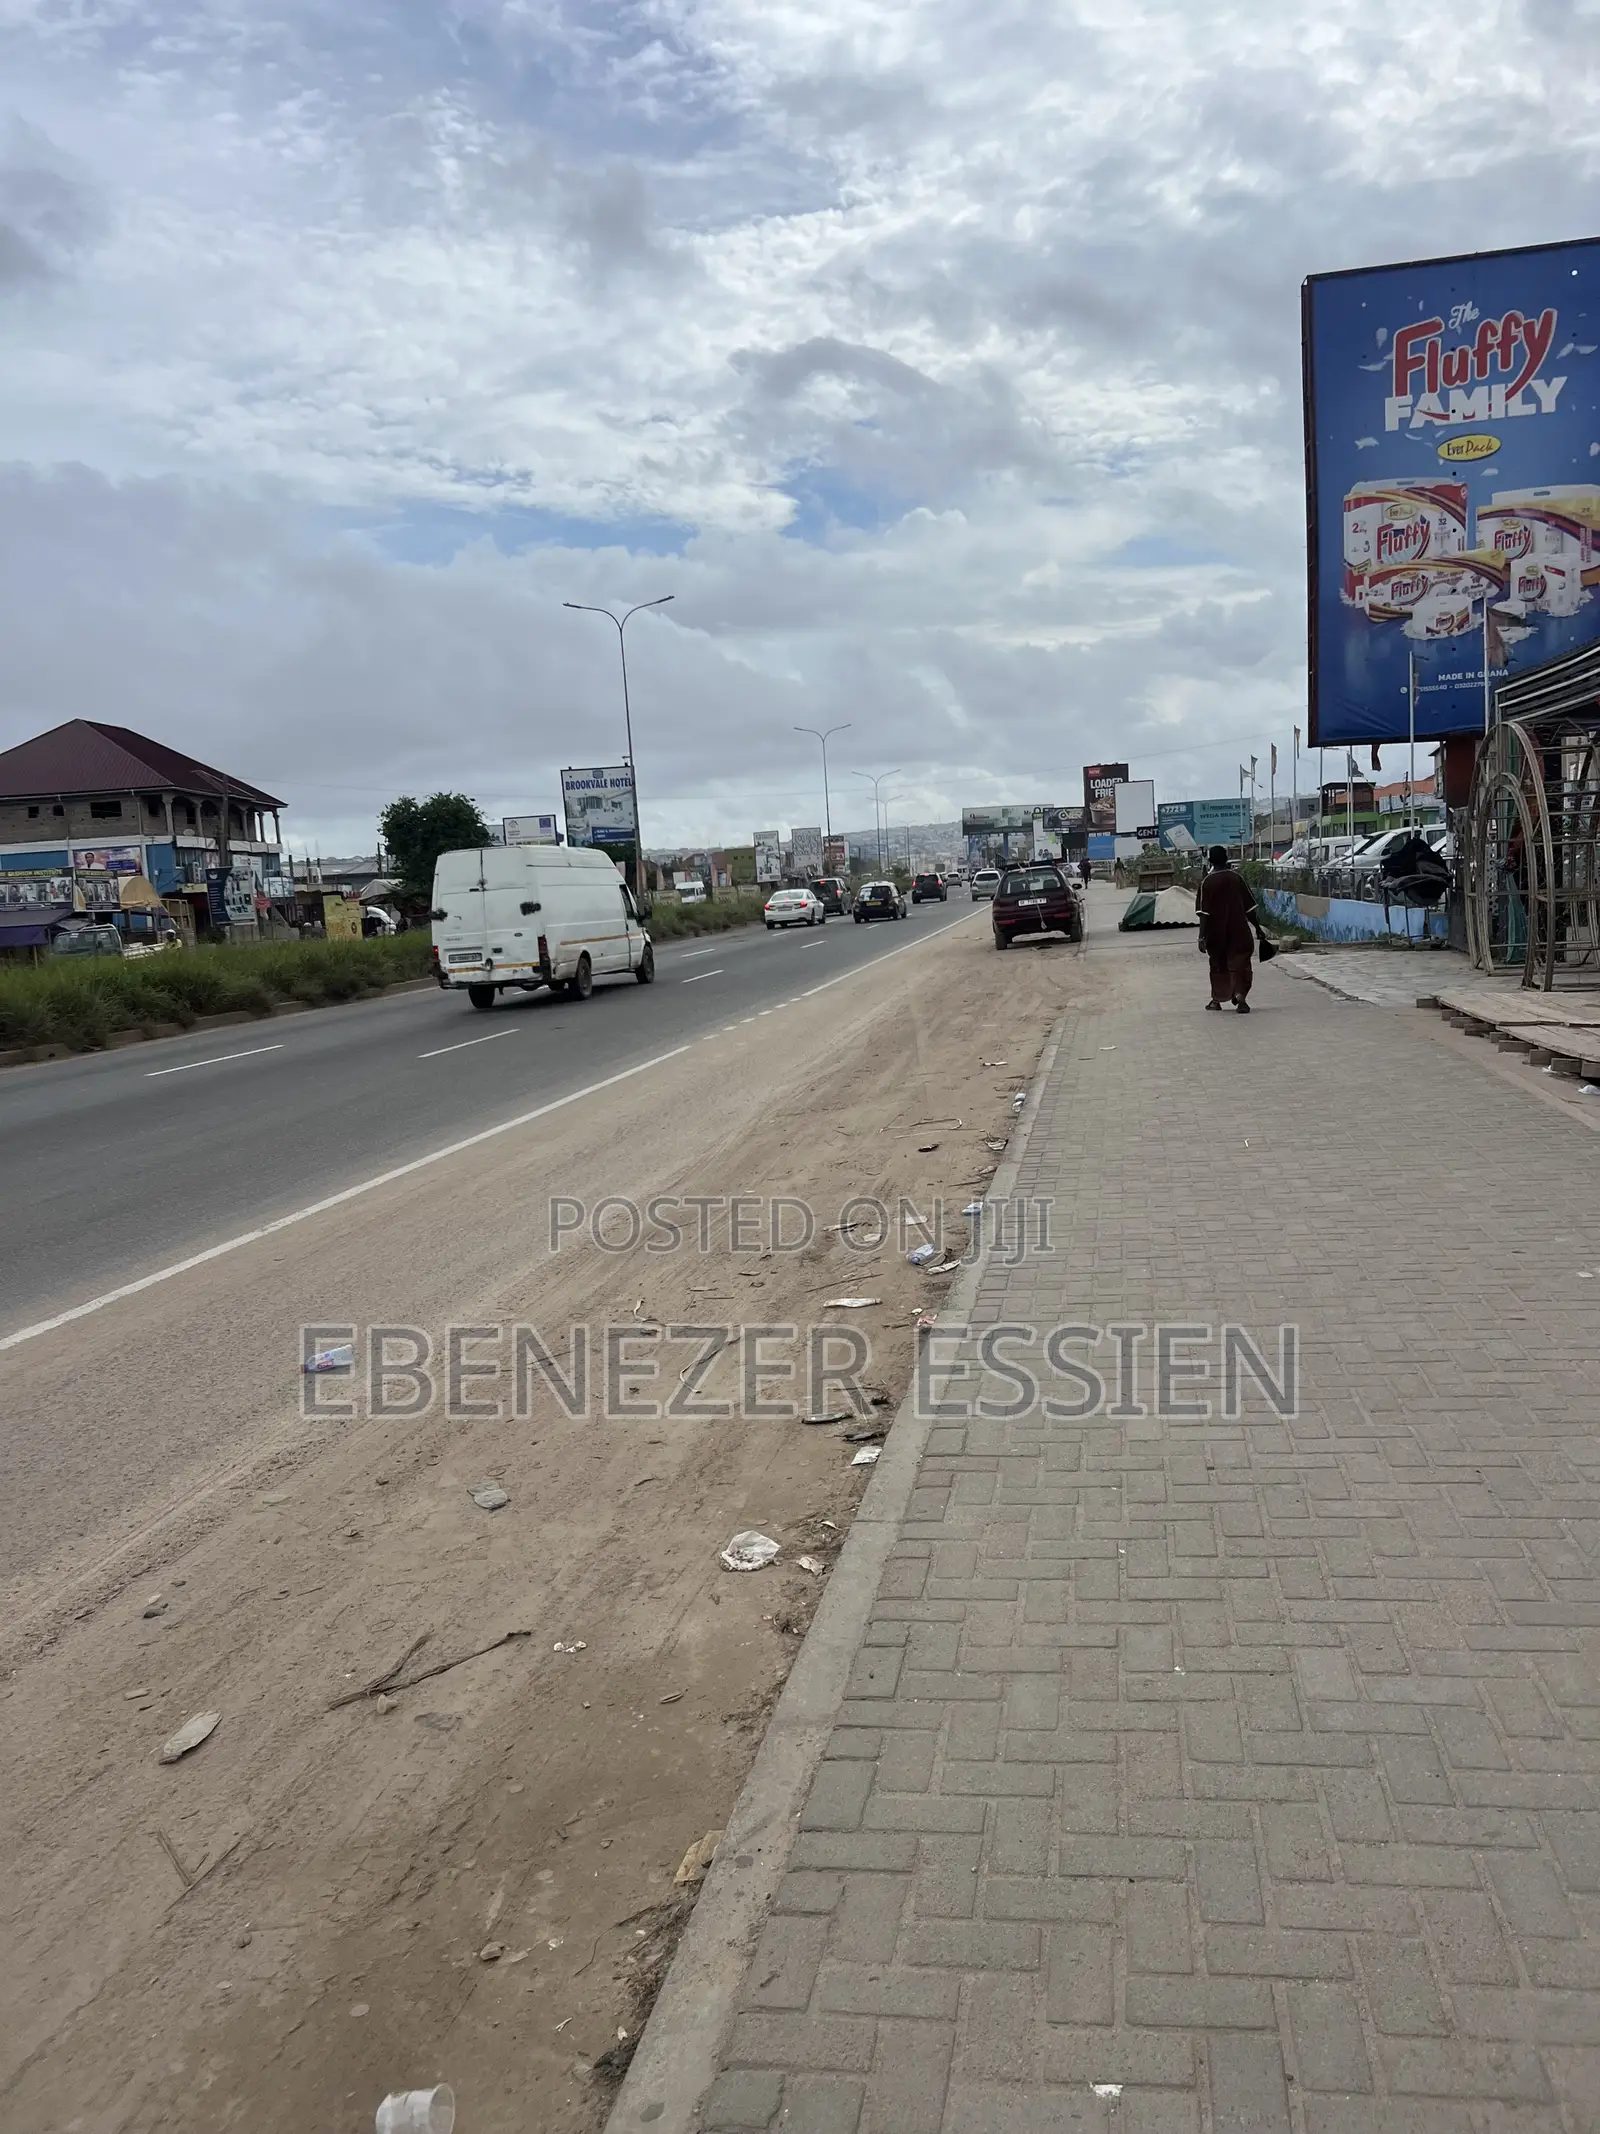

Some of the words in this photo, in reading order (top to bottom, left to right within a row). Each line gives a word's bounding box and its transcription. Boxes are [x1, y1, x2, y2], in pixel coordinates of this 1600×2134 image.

[1449, 300, 1480, 329] The
[1393, 307, 1558, 399] Fluffy
[1384, 375, 1568, 432] FAMILY
[1376, 520, 1431, 562] Fluffy
[1494, 529, 1531, 559] Fluffy
[1391, 576, 1429, 603] Fluffy
[1438, 673, 1463, 681] MADE
[1466, 671, 1475, 679] IN
[565, 779, 608, 791] BROOKVALE
[610, 777, 633, 788] HOTEL
